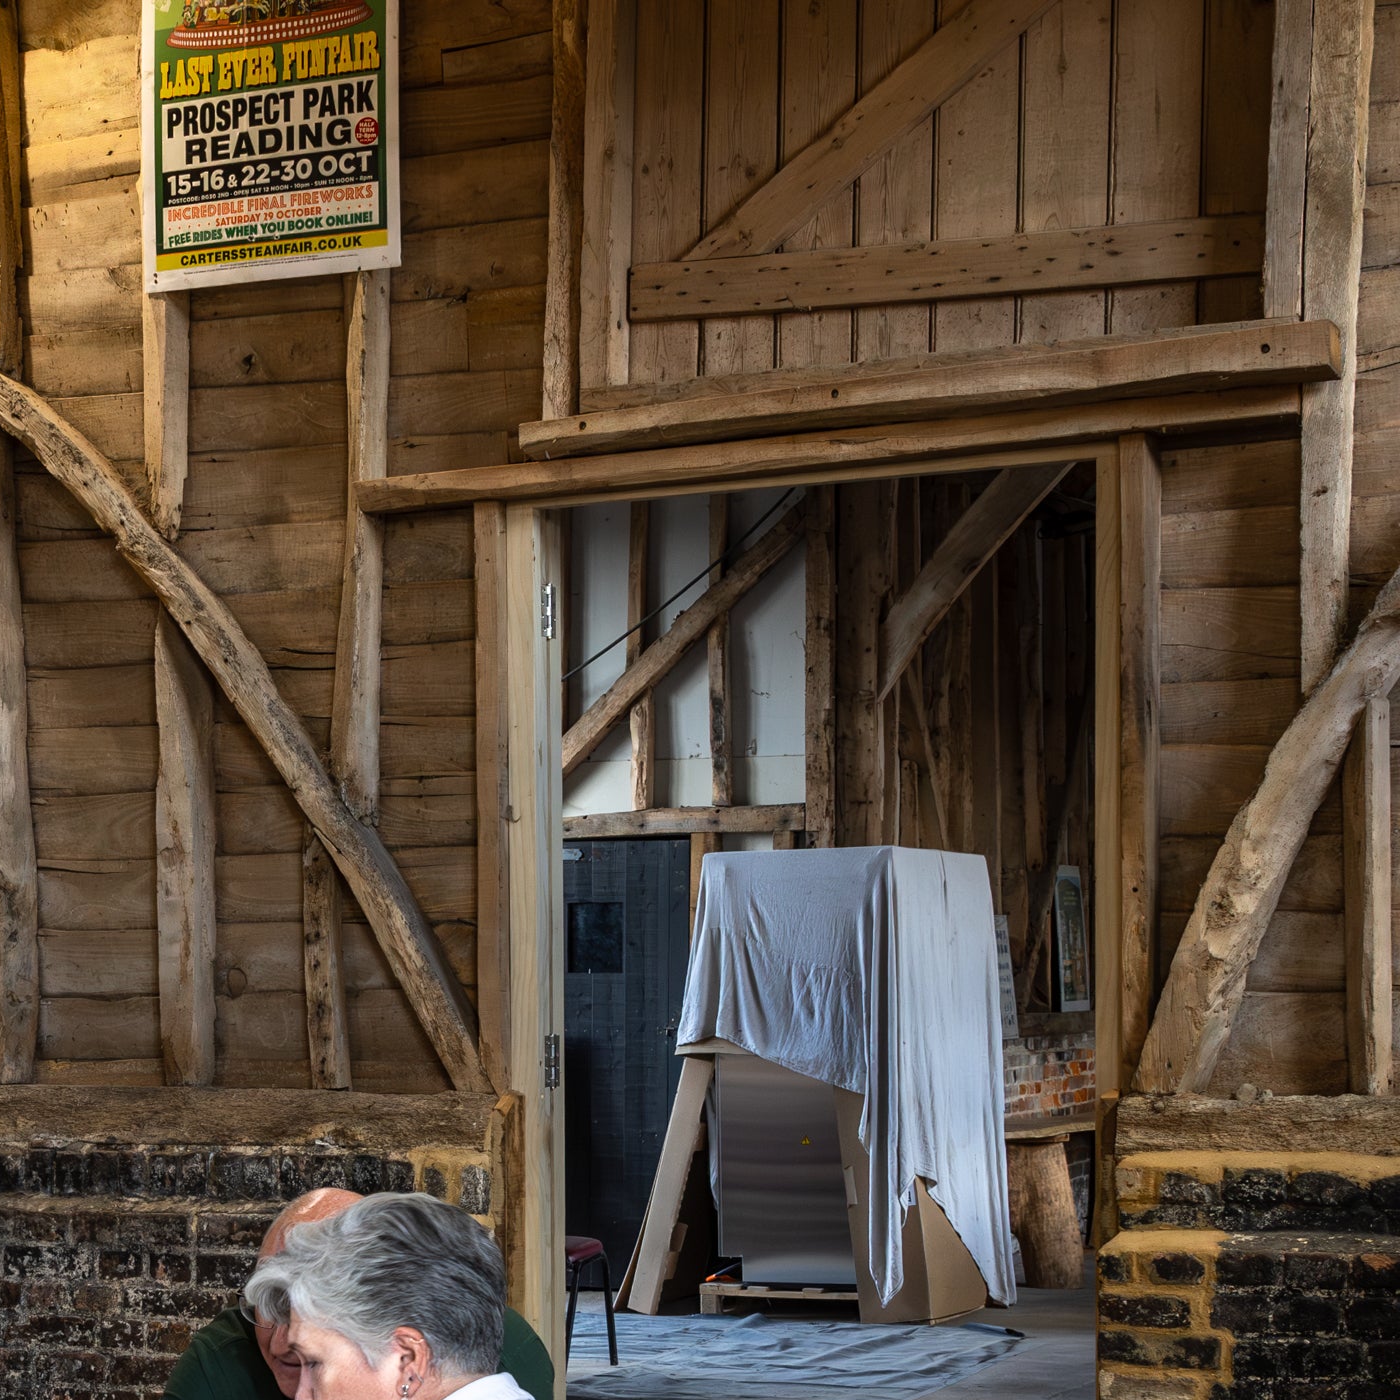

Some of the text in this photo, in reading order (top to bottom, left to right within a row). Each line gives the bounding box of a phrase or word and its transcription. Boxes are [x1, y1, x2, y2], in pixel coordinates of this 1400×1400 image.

[160, 31, 380, 100] LAST EVER FUNFAIR
[167, 80, 375, 139] PROSPECT PARK
[186, 119, 352, 165] READING
[167, 150, 373, 196] 15-16 & 22-30 OCT
[314, 179, 327, 187] SUN
[336, 176, 355, 184] NOON
[167, 184, 373, 222] INCREDIBLE FINAL FIREWORKS
[215, 206, 322, 227] SATURDAY 29 OCTOBER
[168, 211, 373, 248] FREE RIDES WHEN YOU BOOK ONLINE!
[181, 235, 362, 267] CARTERSSTEAMFAIR.CO.UK
